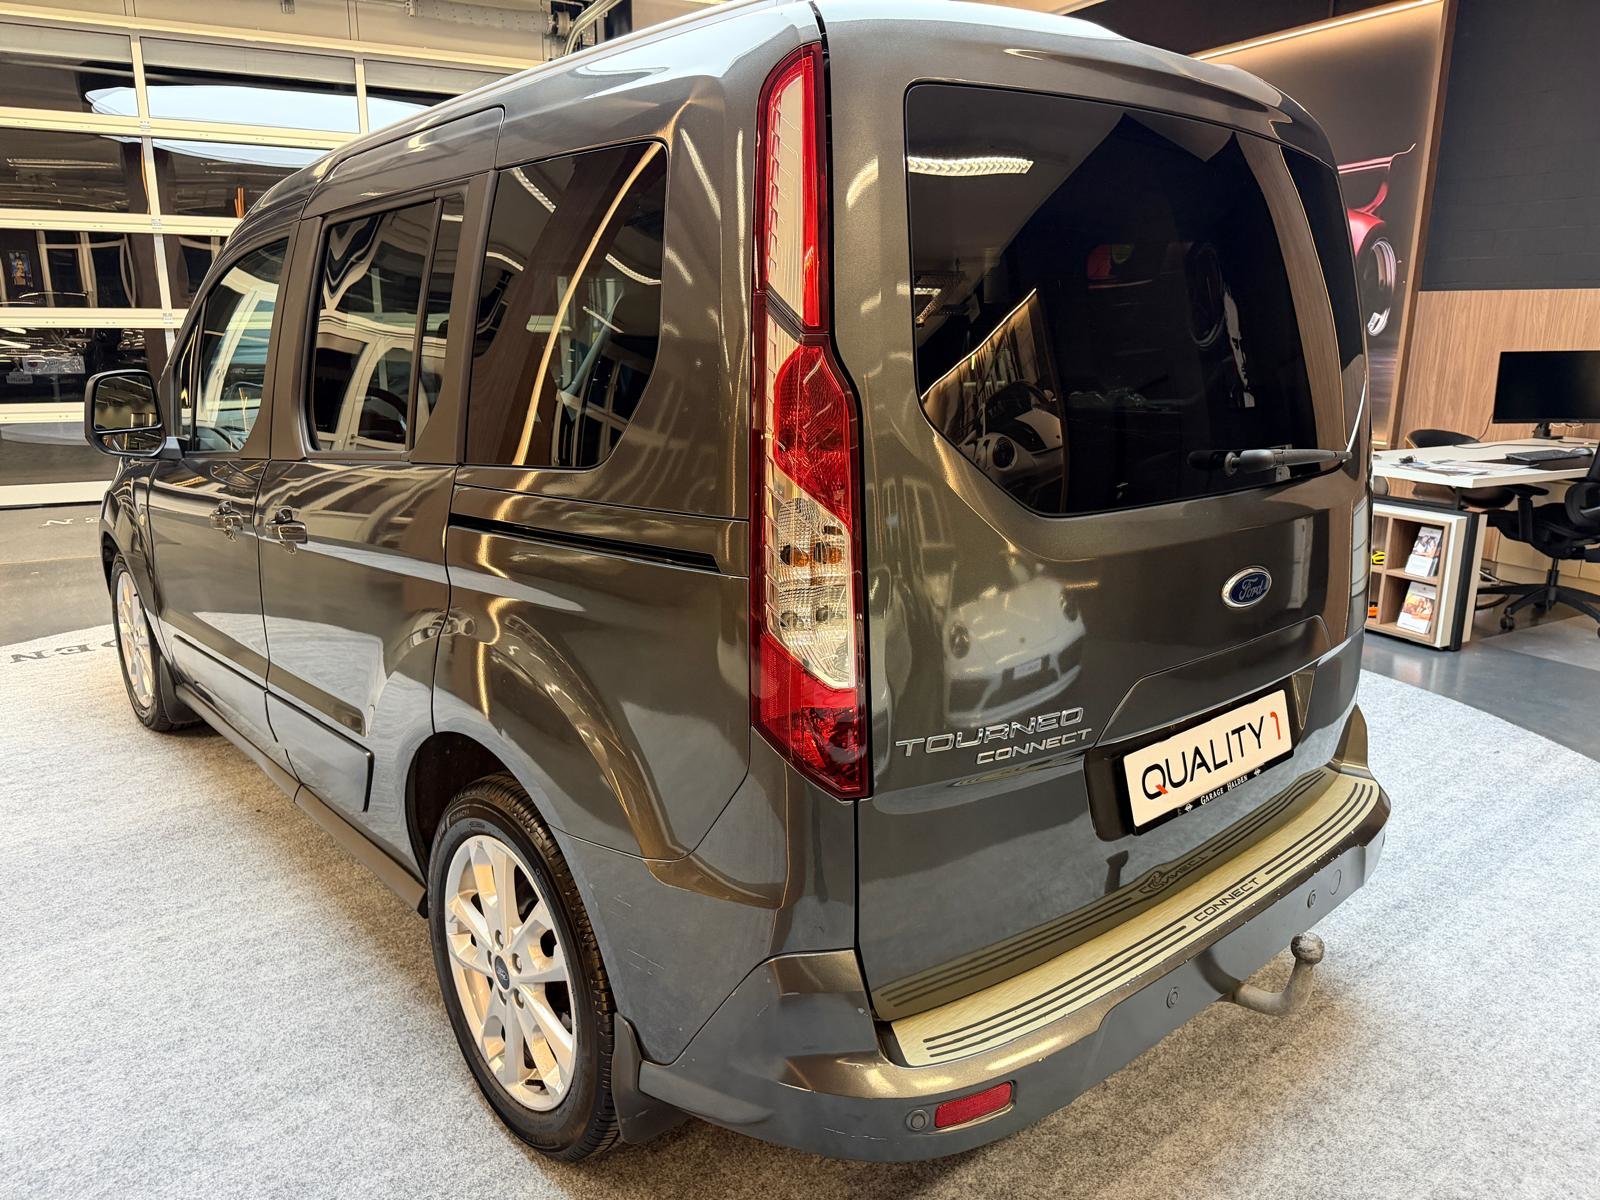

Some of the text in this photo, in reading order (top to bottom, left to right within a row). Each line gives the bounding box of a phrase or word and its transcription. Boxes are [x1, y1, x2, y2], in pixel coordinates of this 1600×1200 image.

[1238, 577, 1264, 600] Ford
[895, 706, 1085, 758] TOURNEO
[975, 727, 1093, 765] CONNECT
[1142, 711, 1281, 800] QUALITY 1
[1200, 774, 1249, 806] GARAGE HALDEN
[1193, 877, 1260, 922] CONNECT
